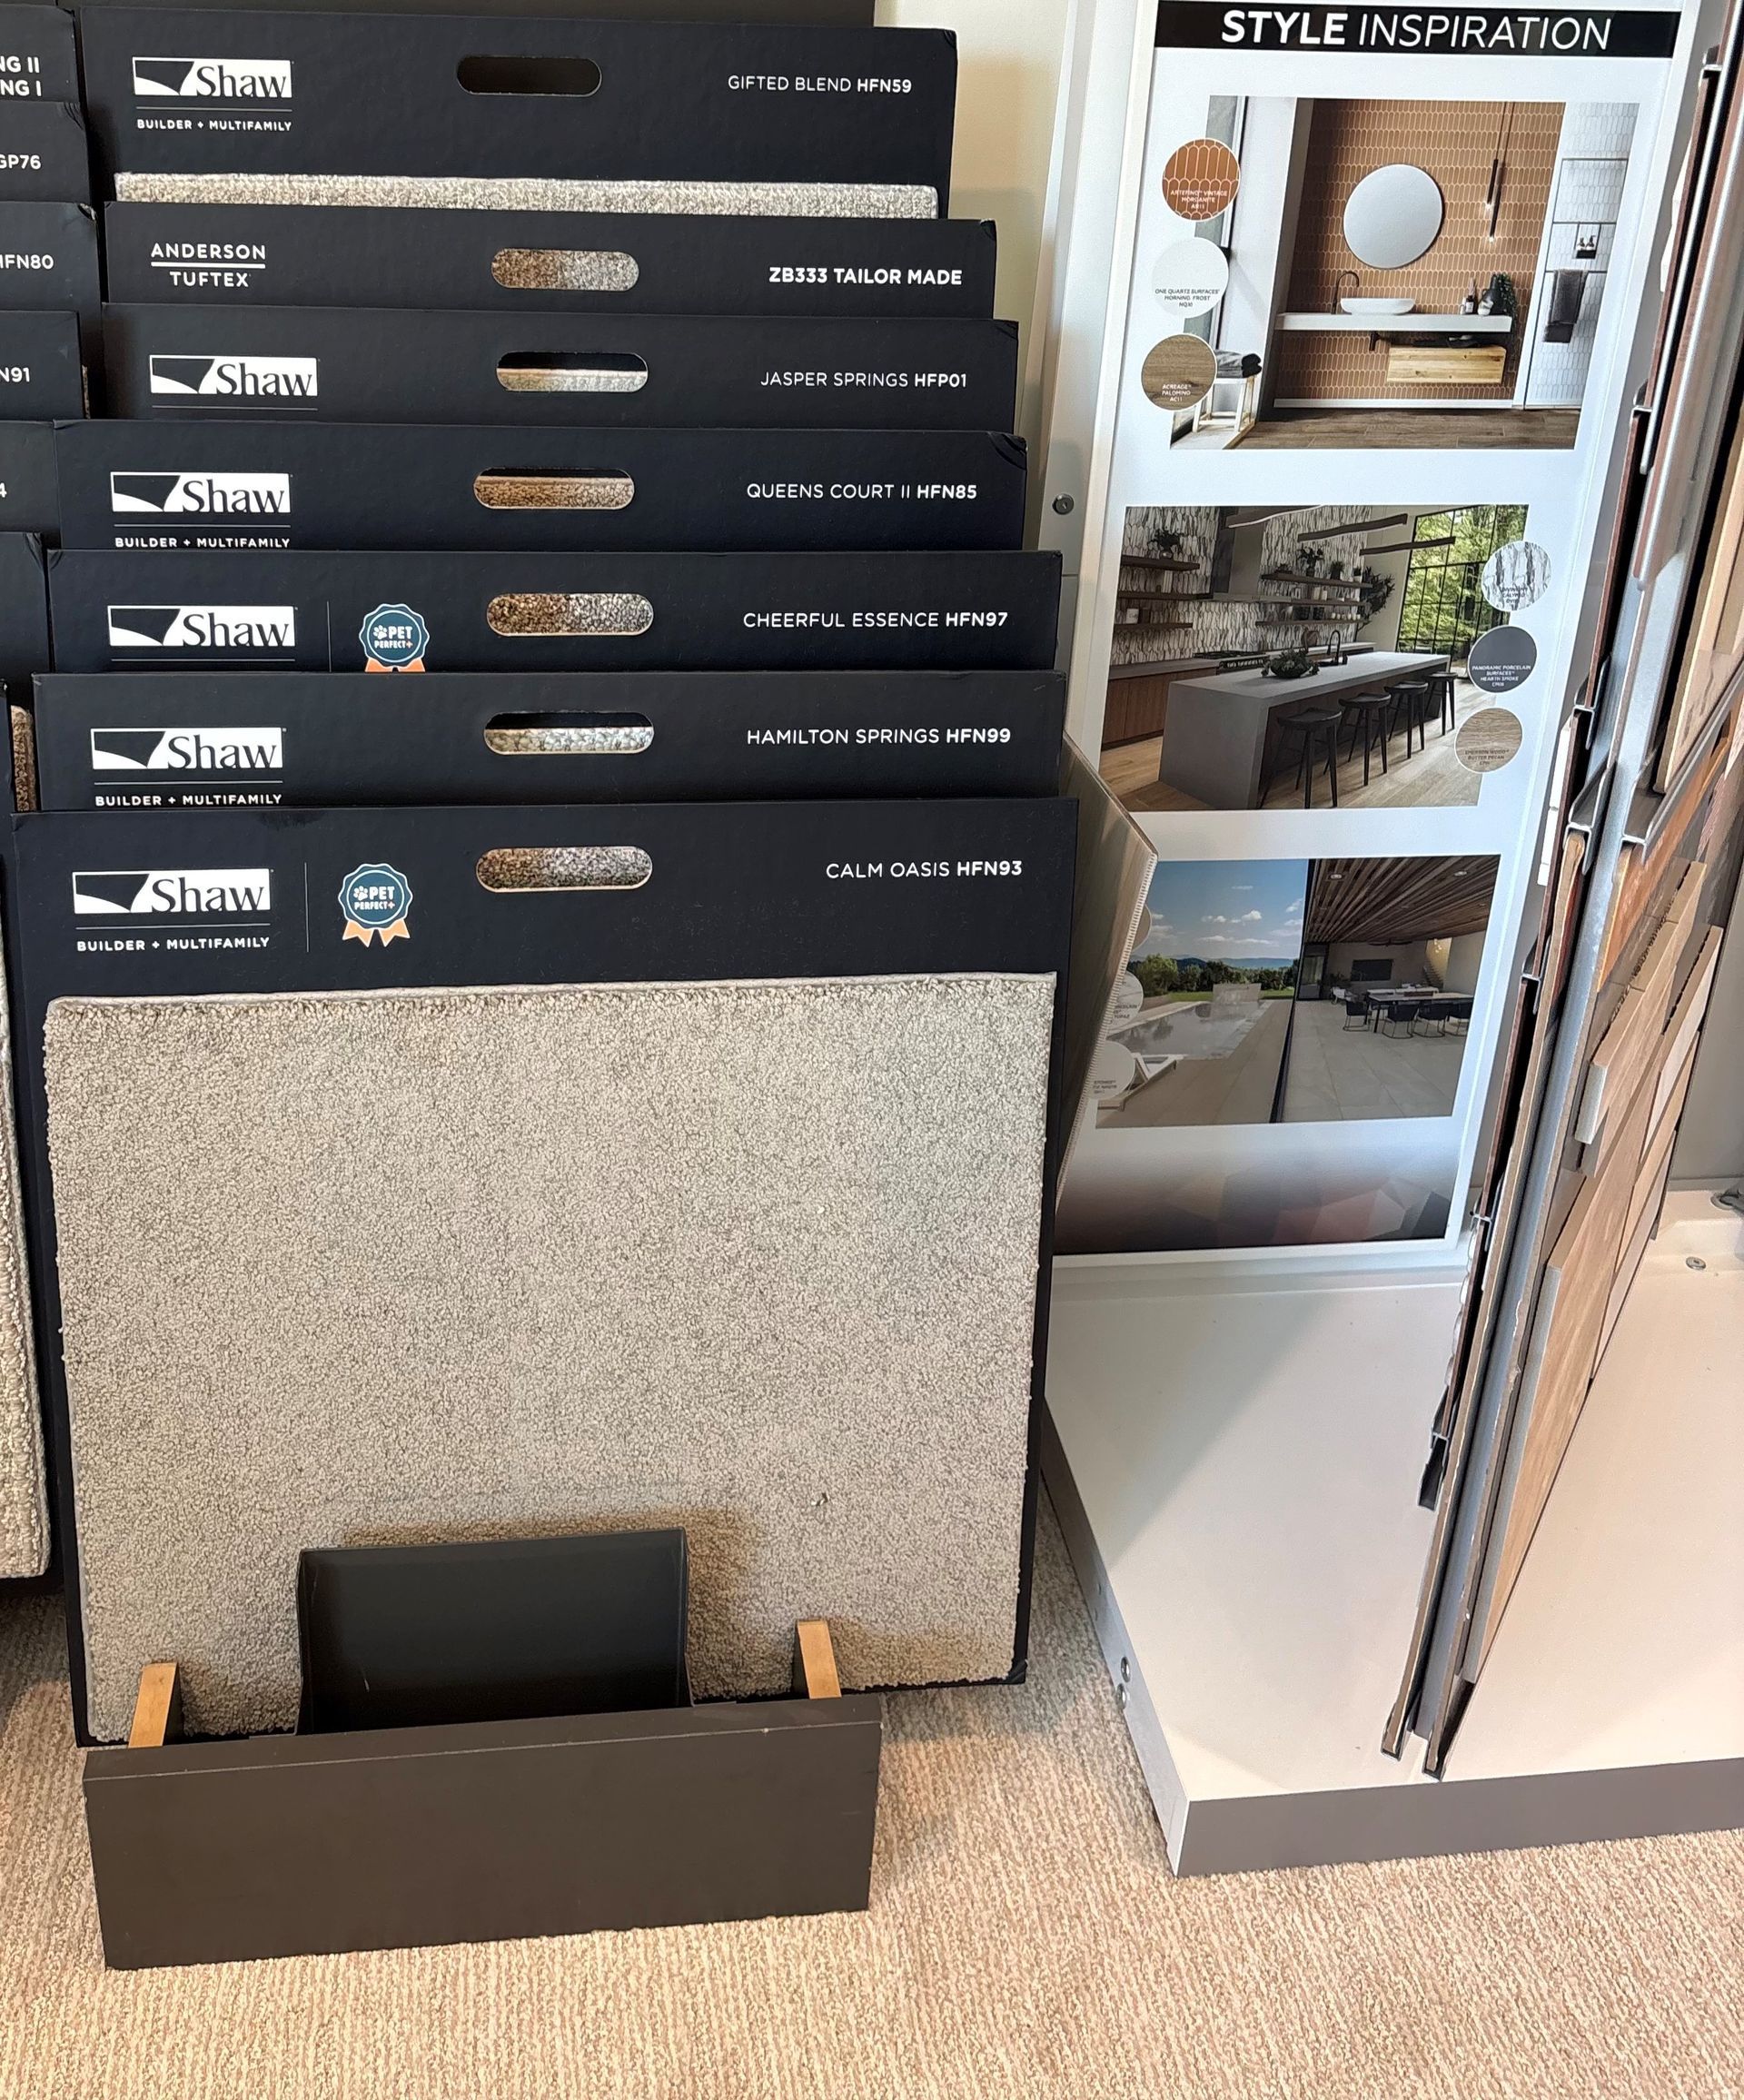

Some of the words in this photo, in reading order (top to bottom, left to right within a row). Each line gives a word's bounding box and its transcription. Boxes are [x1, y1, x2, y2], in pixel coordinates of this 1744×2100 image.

[1222, 10, 1348, 45] STYLE
[1359, 14, 1612, 50] INSPIRATION
[196, 64, 287, 97] Shaw
[728, 74, 789, 91] GIFTED
[795, 76, 852, 93] BLEND
[857, 78, 912, 94] HFN59
[136, 118, 193, 130] BUILDER
[209, 120, 292, 132] MULTIFAMILY
[150, 243, 266, 261] ANDERSON
[169, 271, 249, 288] TUFTEX
[768, 266, 828, 283] ZB333
[833, 267, 902, 284] TAILOR
[907, 269, 963, 285] MADE
[216, 362, 313, 396] Shaw
[760, 371, 827, 387] JASPER
[833, 371, 908, 388] SPRINGS
[914, 372, 966, 388] HFP01
[182, 478, 285, 512] Shaw
[747, 482, 824, 499] QUEENS
[829, 483, 895, 500] COURT
[901, 484, 910, 499] II
[917, 484, 977, 500] HFN85
[114, 537, 177, 548] BUILDER
[196, 537, 290, 548] MULTIFAMILY
[743, 612, 846, 628] CHEERFUL
[852, 611, 939, 628] ESSENCE
[946, 611, 1008, 627] HFN97
[182, 611, 290, 647] Shaw
[388, 625, 413, 639] PET
[747, 728, 849, 745] HAMILTON
[855, 728, 940, 744] SPRINGS
[946, 728, 1011, 744] HFN99
[167, 733, 278, 769] Shaw
[94, 795, 162, 807] BUILDER
[182, 794, 282, 806] MULTIFAMILY
[826, 862, 883, 879] CALM
[889, 861, 950, 878] OASIS
[956, 860, 1023, 877] HFN93
[152, 876, 265, 913] Shaw
[369, 886, 395, 900] PET
[76, 938, 145, 952] BUILDER
[166, 936, 270, 950] MULTIFAMILY
